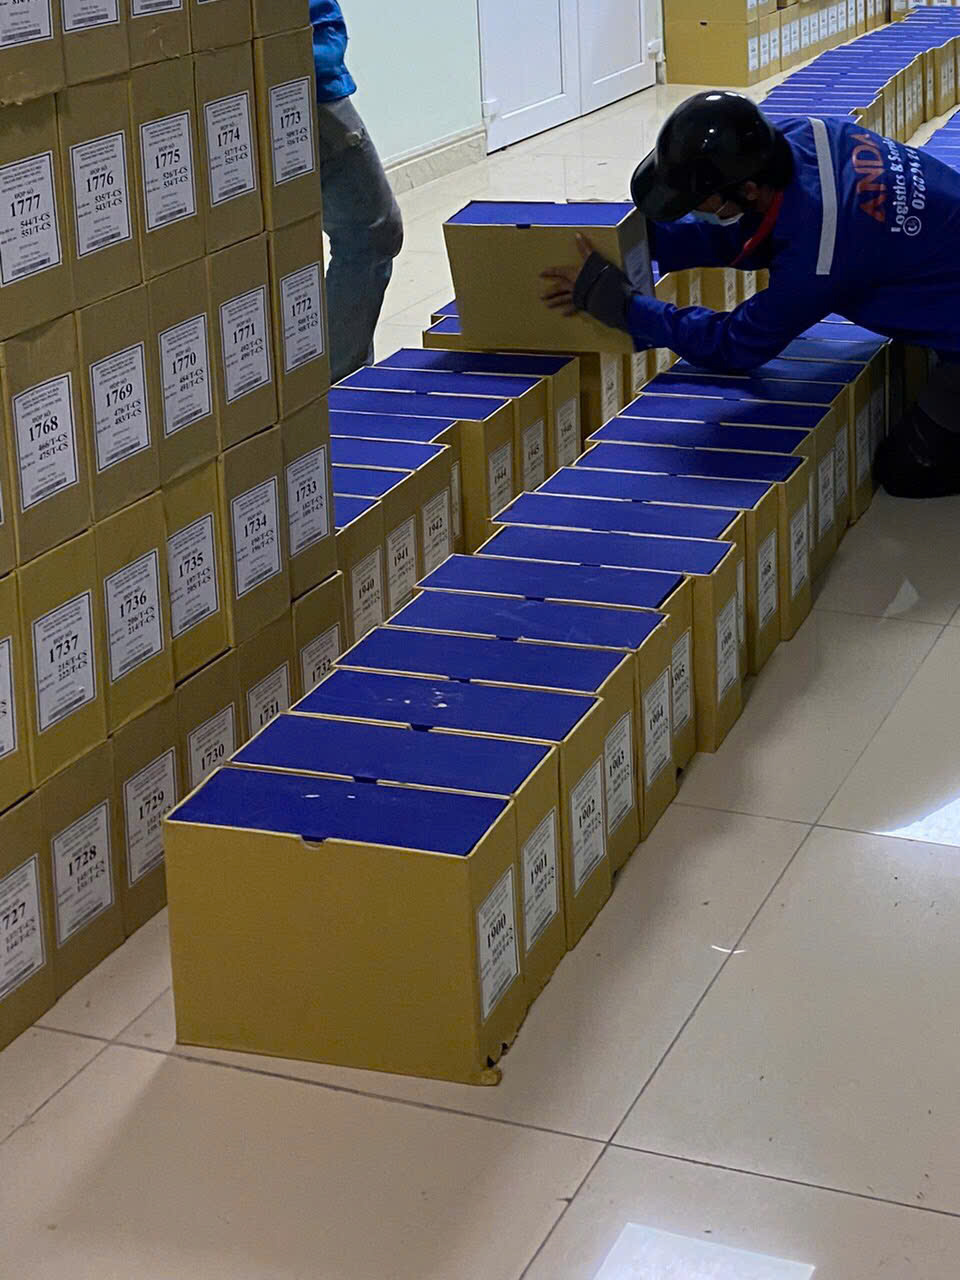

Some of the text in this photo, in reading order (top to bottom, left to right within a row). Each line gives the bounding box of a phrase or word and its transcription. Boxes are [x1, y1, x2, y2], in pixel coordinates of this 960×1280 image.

[280, 112, 300, 128] 1773
[217, 127, 240, 147] 1774
[155, 149, 180, 170] 1775
[890, 163, 904, 172] &
[86, 171, 114, 192] 1776
[10, 194, 41, 218] 1777
[94, 190, 122, 204] 535/T-CS
[96, 198, 123, 212] 543/T-CS
[20, 212, 50, 229] 544/T-CS
[21, 222, 52, 238] 551/T-CS
[291, 298, 312, 317] 1772
[233, 323, 255, 344] 1771
[172, 352, 196, 375] 1770
[106, 384, 132, 408] 1769
[28, 416, 58, 442] 1768
[296, 481, 316, 502] 1733
[244, 514, 266, 538] 1734
[428, 518, 442, 536] 1942
[179, 552, 204, 578] 1735
[394, 547, 408, 566] 1941
[358, 578, 374, 599] 1940
[119, 592, 146, 618] 1736
[50, 634, 78, 664] 1737
[260, 701, 279, 725] 1731
[202, 744, 224, 770] 1730
[140, 791, 164, 820] 1729
[579, 800, 595, 828] 1902
[69, 846, 97, 876] 1728
[530, 854, 547, 885] 1901
[3, 902, 26, 930] 727
[488, 913, 506, 948] 1900
